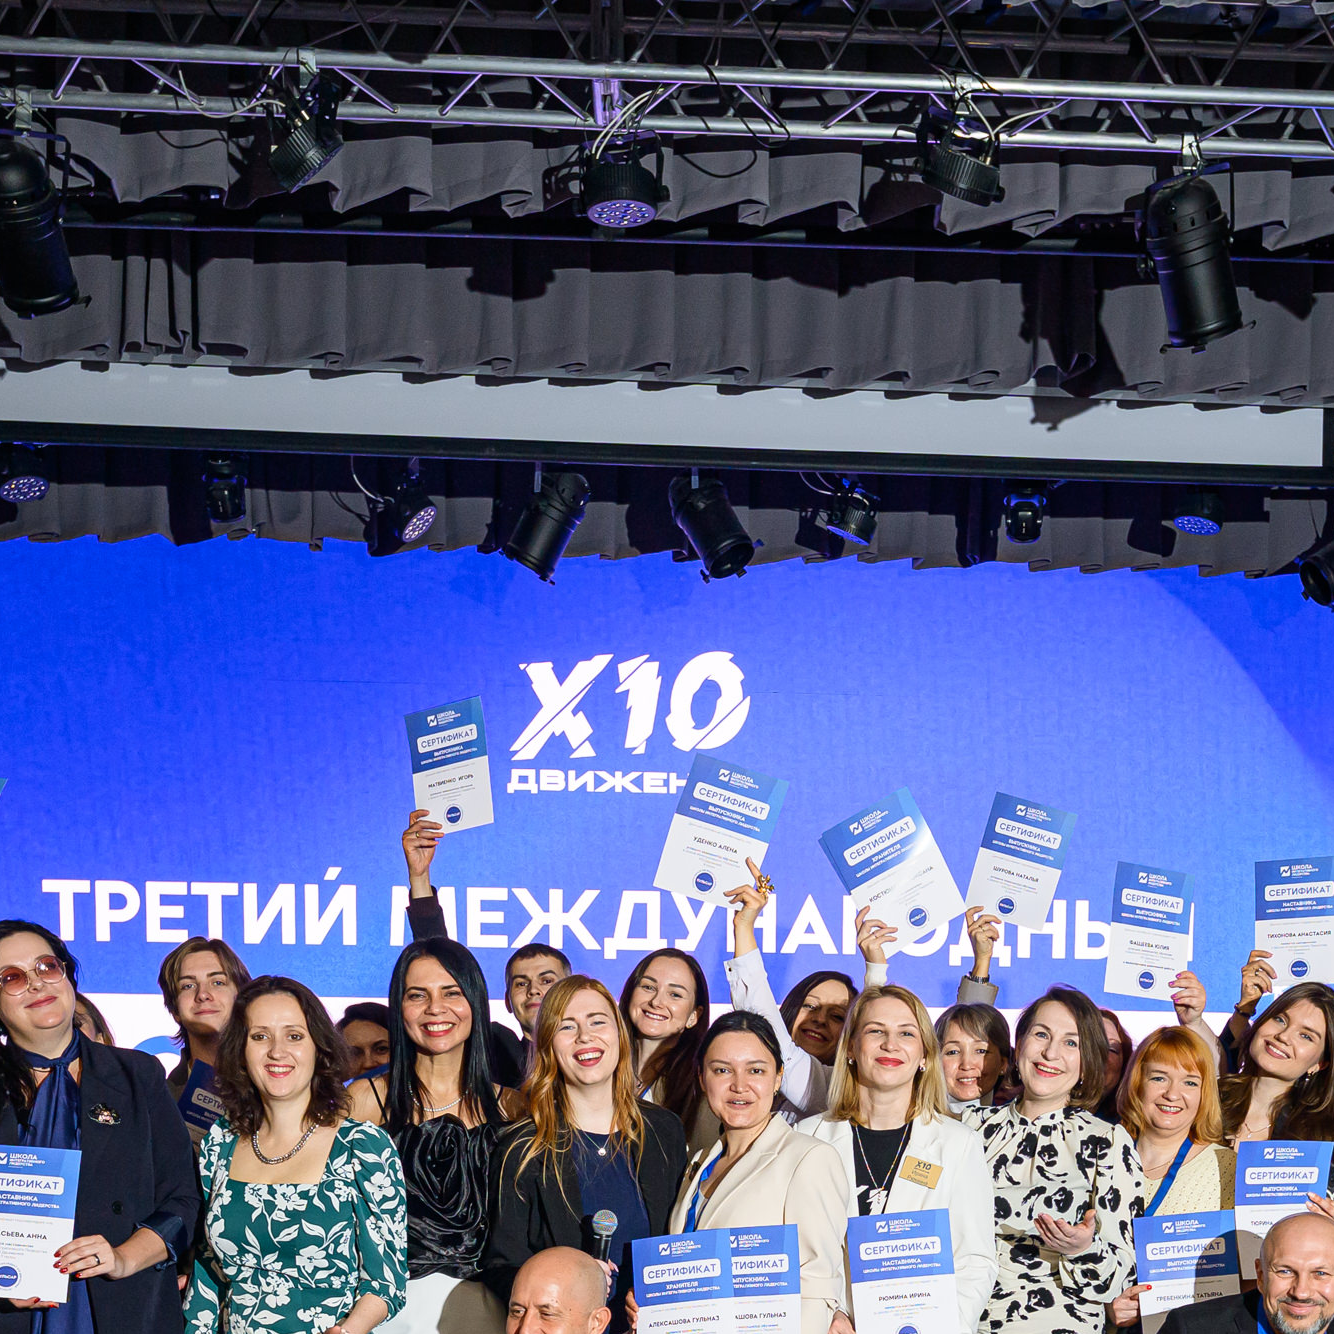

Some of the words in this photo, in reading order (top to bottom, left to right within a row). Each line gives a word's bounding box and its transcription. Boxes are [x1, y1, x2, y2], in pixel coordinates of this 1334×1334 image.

[421, 728, 474, 749] СЕРТИФИКАТ
[507, 768, 689, 794] ДВИЖЕН
[699, 787, 765, 815] СЕРТИФИКАТ
[849, 821, 911, 860] СЕРТИФИКАТ
[999, 822, 1057, 845] СЕРТИФИКАТ
[693, 836, 718, 848] УДЕНКО
[1269, 886, 1331, 897] СЕРТИФИКАТ
[42, 867, 357, 946] ТРЕТИЙ
[1125, 893, 1180, 909] СЕРТИФИКАТ
[1249, 1171, 1314, 1181] СЕРТИФИКАТ
[864, 1241, 936, 1256] СЕРТИФИКАТ
[1151, 1243, 1221, 1256] СЕРТИФИКАТ
[648, 1263, 716, 1279] СЕРТИФИКАТ
[732, 1259, 785, 1270] ТИФИКАТ
[879, 1294, 908, 1302] РЮМИНА
[648, 1318, 691, 1328] АЛЕКСАШОВА
[692, 1315, 720, 1324] ГУЛЬНАЗ
